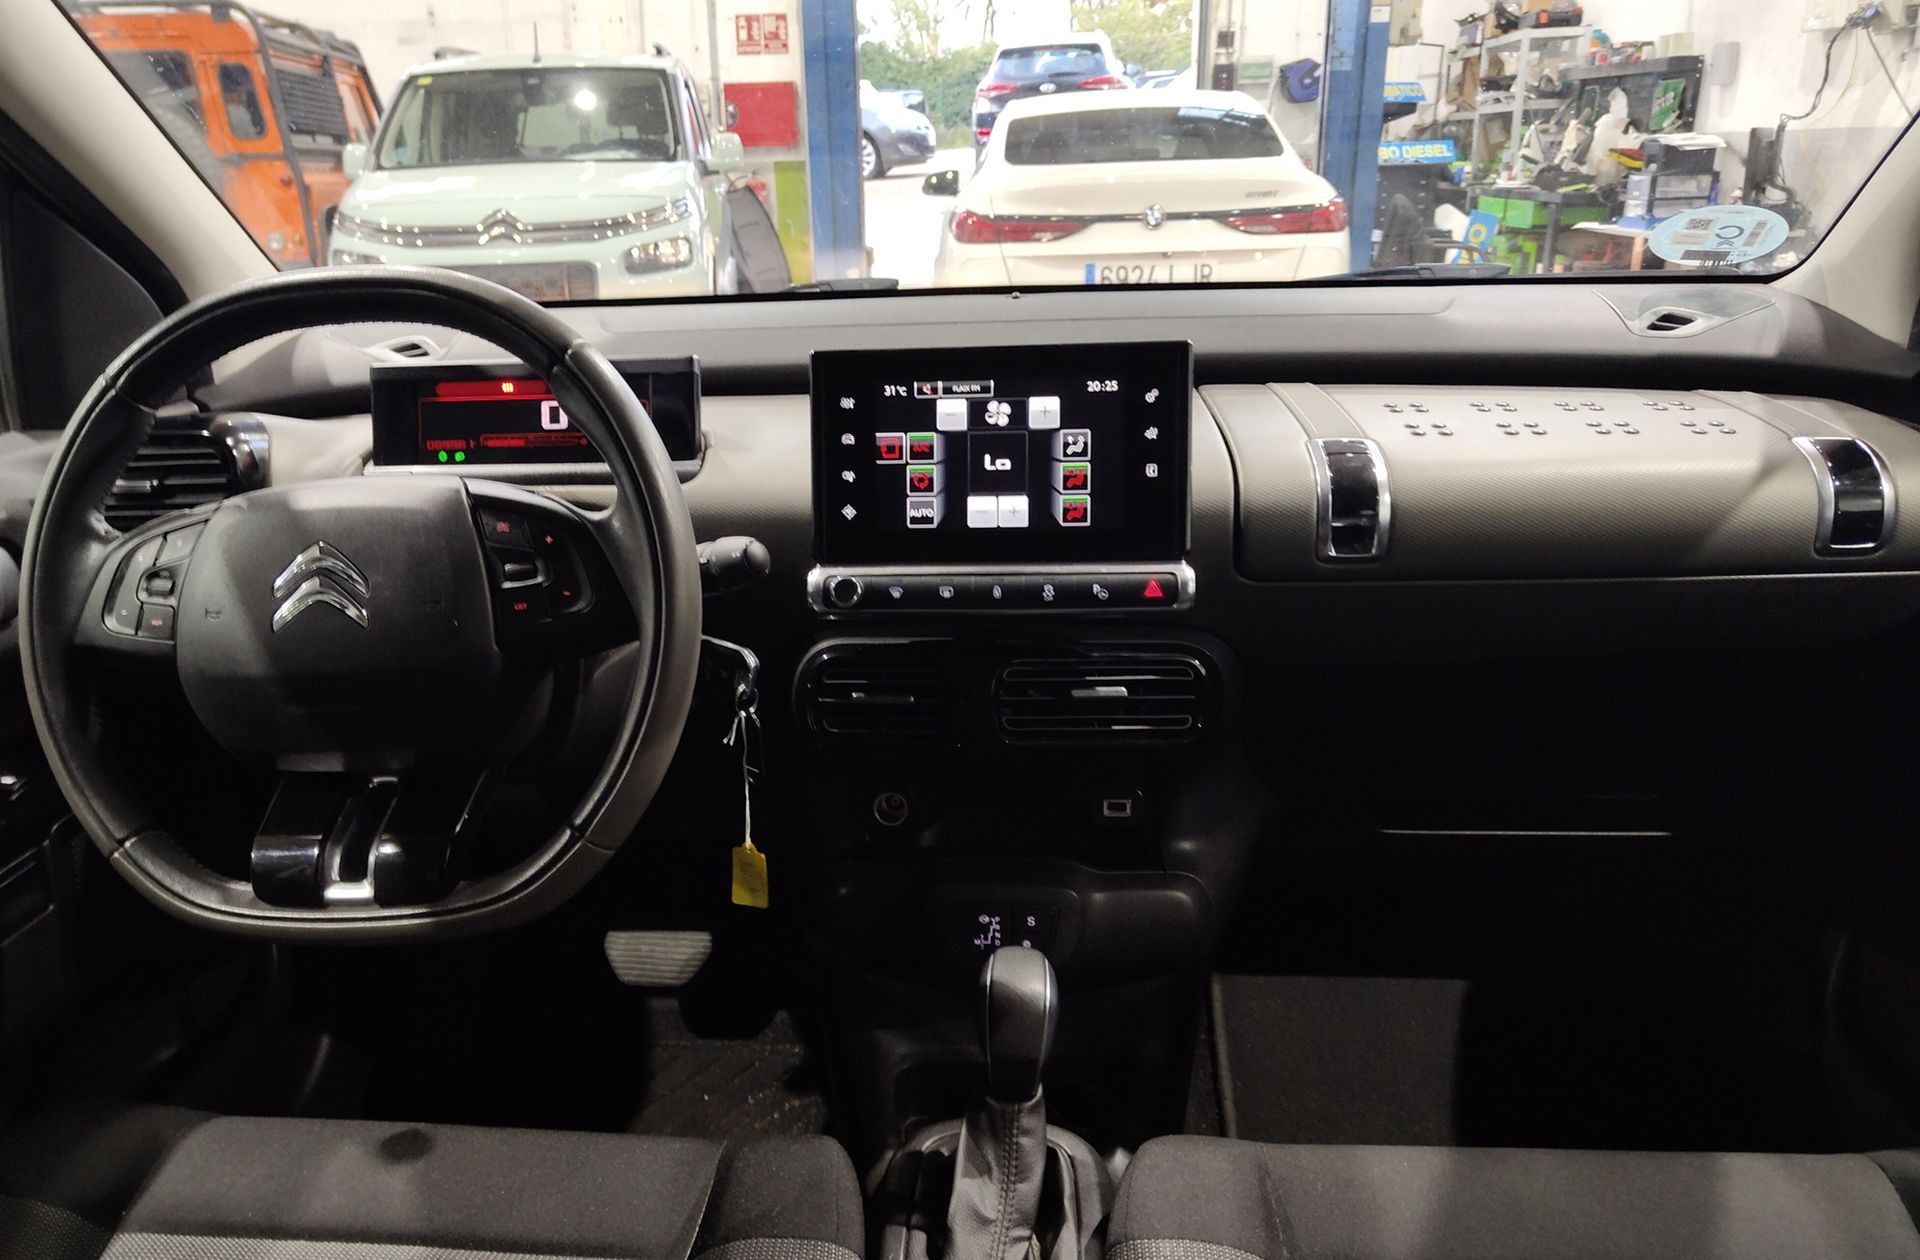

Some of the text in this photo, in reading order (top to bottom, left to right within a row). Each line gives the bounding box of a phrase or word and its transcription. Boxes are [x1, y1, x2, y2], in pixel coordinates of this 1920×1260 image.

[1402, 143, 1453, 158] DIESEL
[1086, 380, 1119, 392] 20:25
[909, 508, 934, 518] AUTO
[1026, 915, 1037, 927] S
